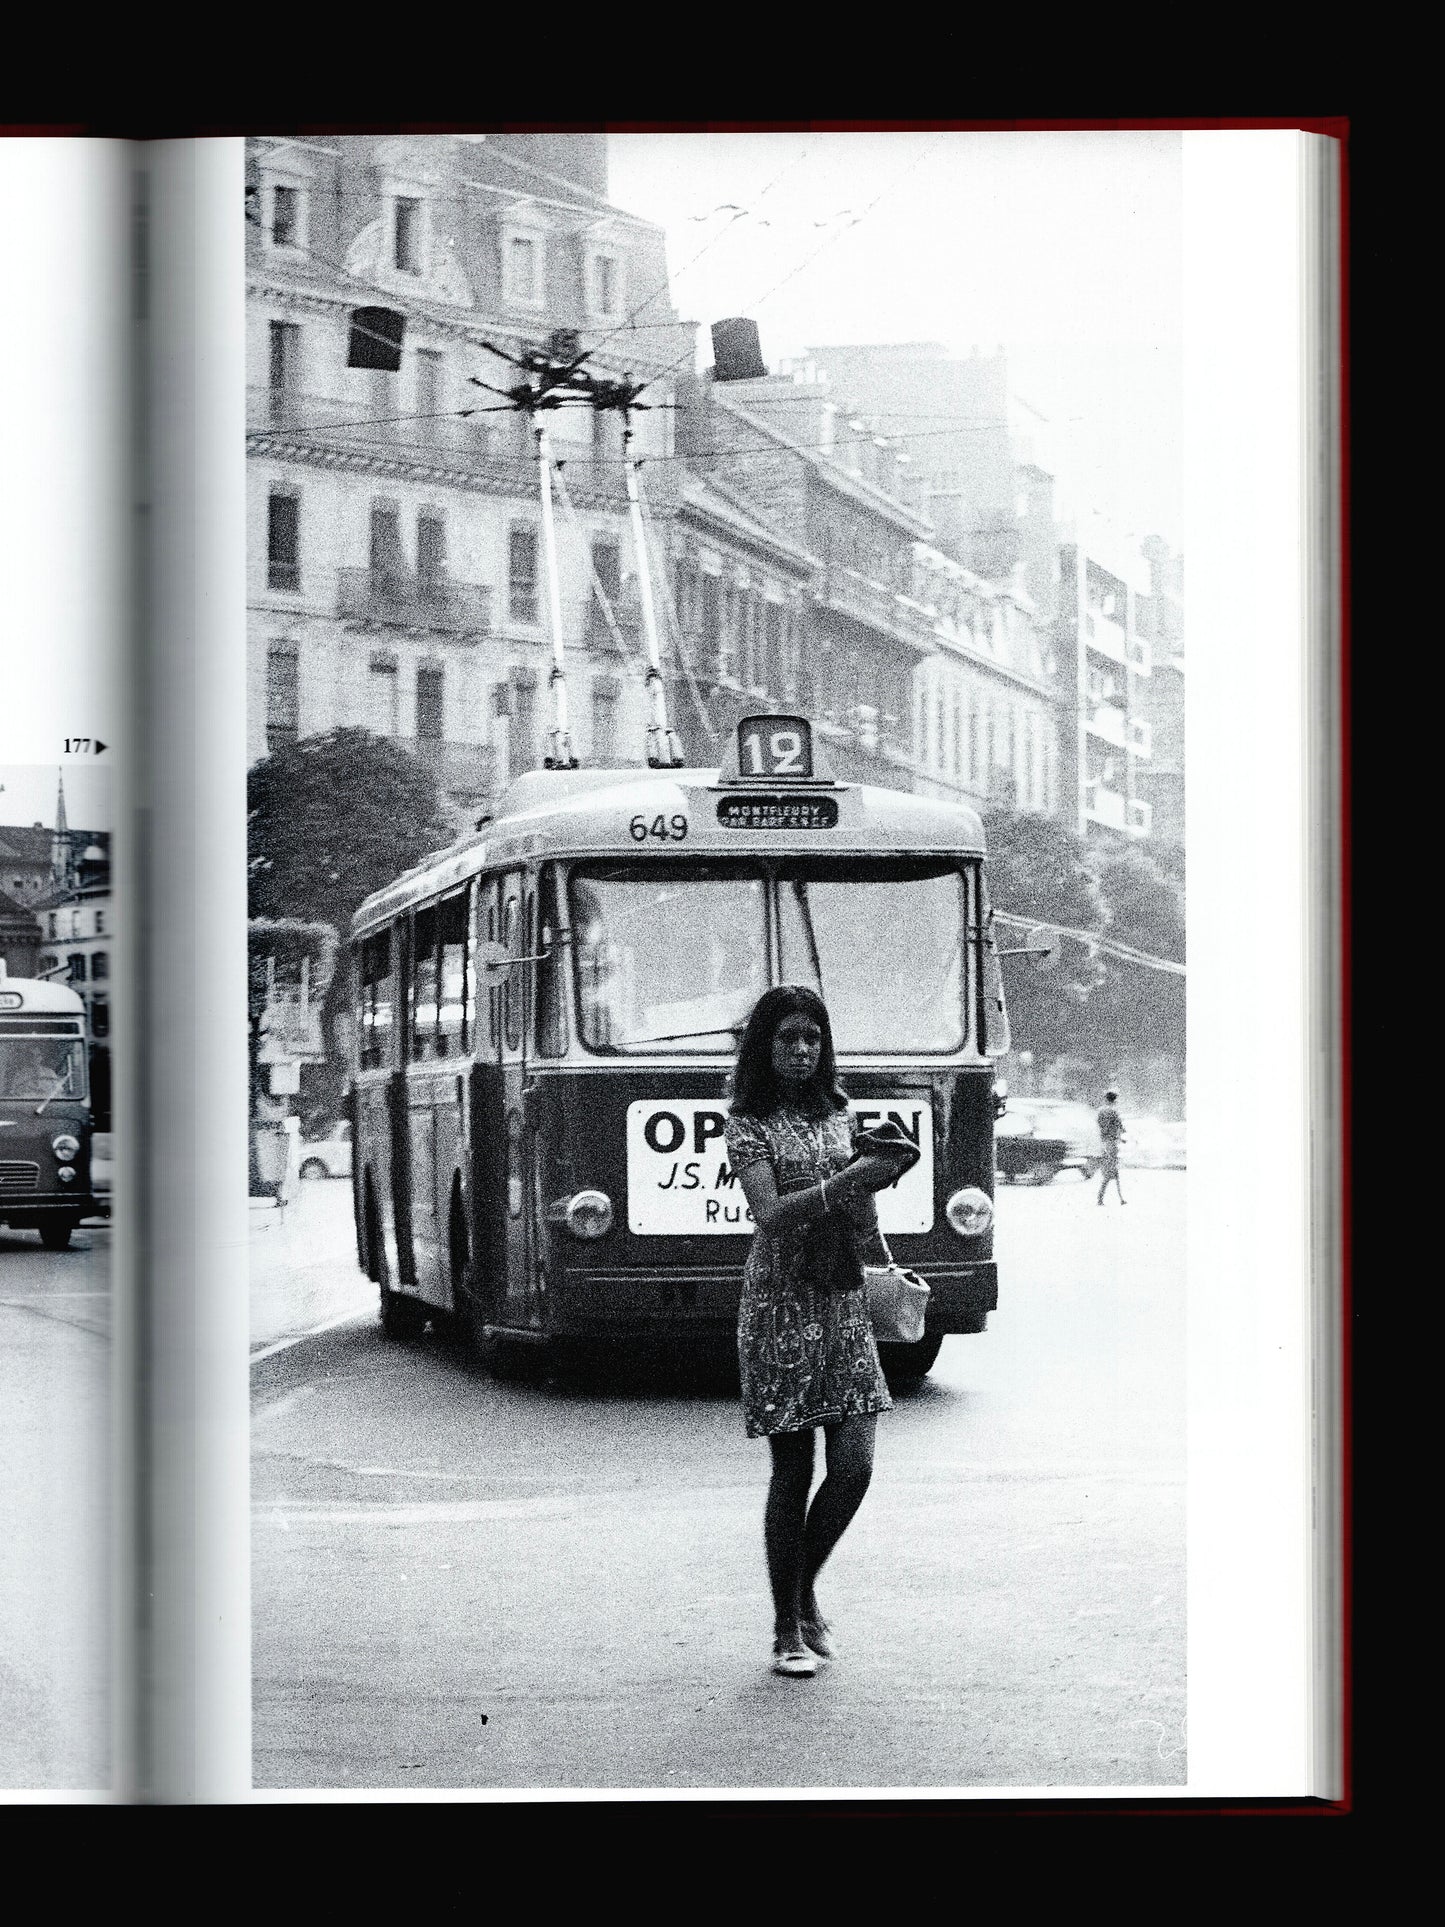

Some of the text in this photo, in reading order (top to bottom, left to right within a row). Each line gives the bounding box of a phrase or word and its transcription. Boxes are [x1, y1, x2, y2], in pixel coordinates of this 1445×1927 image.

[63, 738, 92, 754] 177
[743, 731, 804, 775] 12
[629, 814, 689, 842] 649
